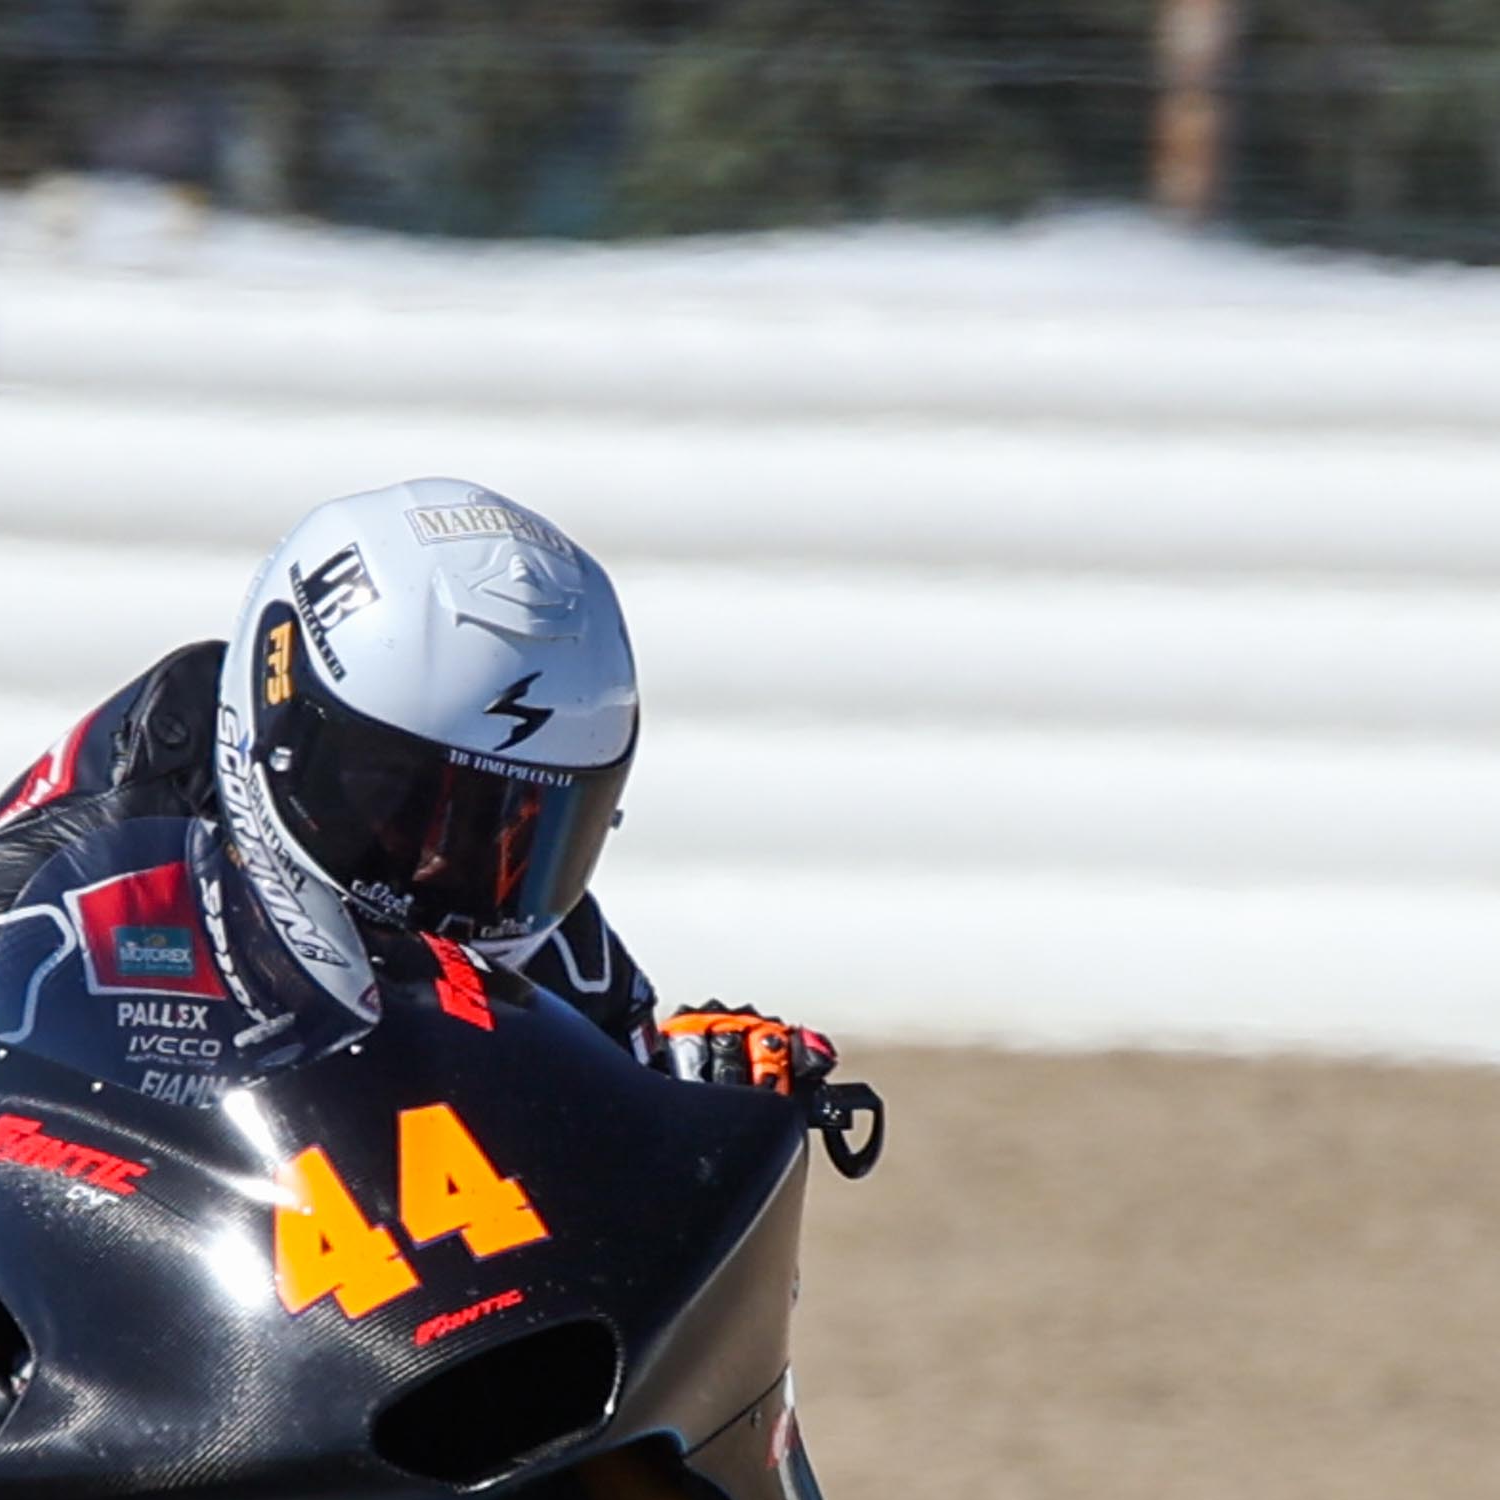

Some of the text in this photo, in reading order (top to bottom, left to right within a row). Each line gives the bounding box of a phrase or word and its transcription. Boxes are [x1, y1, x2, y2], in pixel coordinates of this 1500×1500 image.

[216, 703, 330, 950] SCORPION
[119, 943, 192, 964] MOTOREX
[117, 1001, 210, 1030] PALLEX
[128, 1034, 222, 1058] IVECO
[273, 1102, 550, 1319] 44
